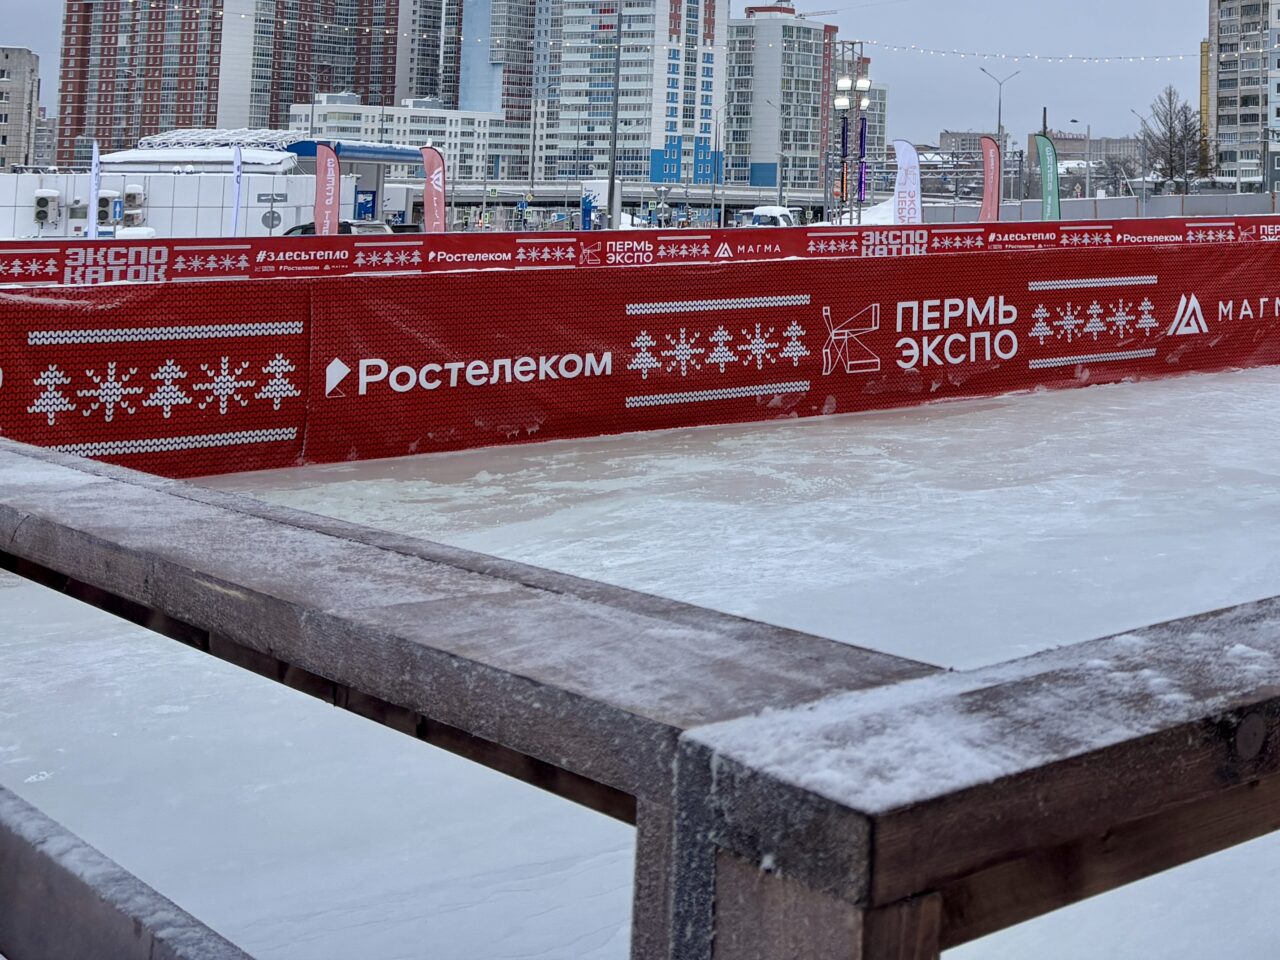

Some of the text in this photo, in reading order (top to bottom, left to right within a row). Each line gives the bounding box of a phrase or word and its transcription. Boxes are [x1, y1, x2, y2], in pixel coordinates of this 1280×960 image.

[861, 230, 928, 245] ЭКСПО
[1123, 233, 1183, 243] Ростелеком
[606, 240, 653, 252] ПЕРМЬ
[737, 244, 781, 253] МАГМА
[861, 243, 928, 256] КАТОК
[65, 246, 169, 266] ЭКСПО
[437, 251, 512, 262] Ростелеком
[606, 251, 653, 264] ЭКСПО
[63, 264, 168, 285] КАТОК
[896, 295, 1018, 332] ПЕРМЬ
[895, 329, 1019, 369] ЭКСПО
[358, 351, 612, 395] Ростелеком
